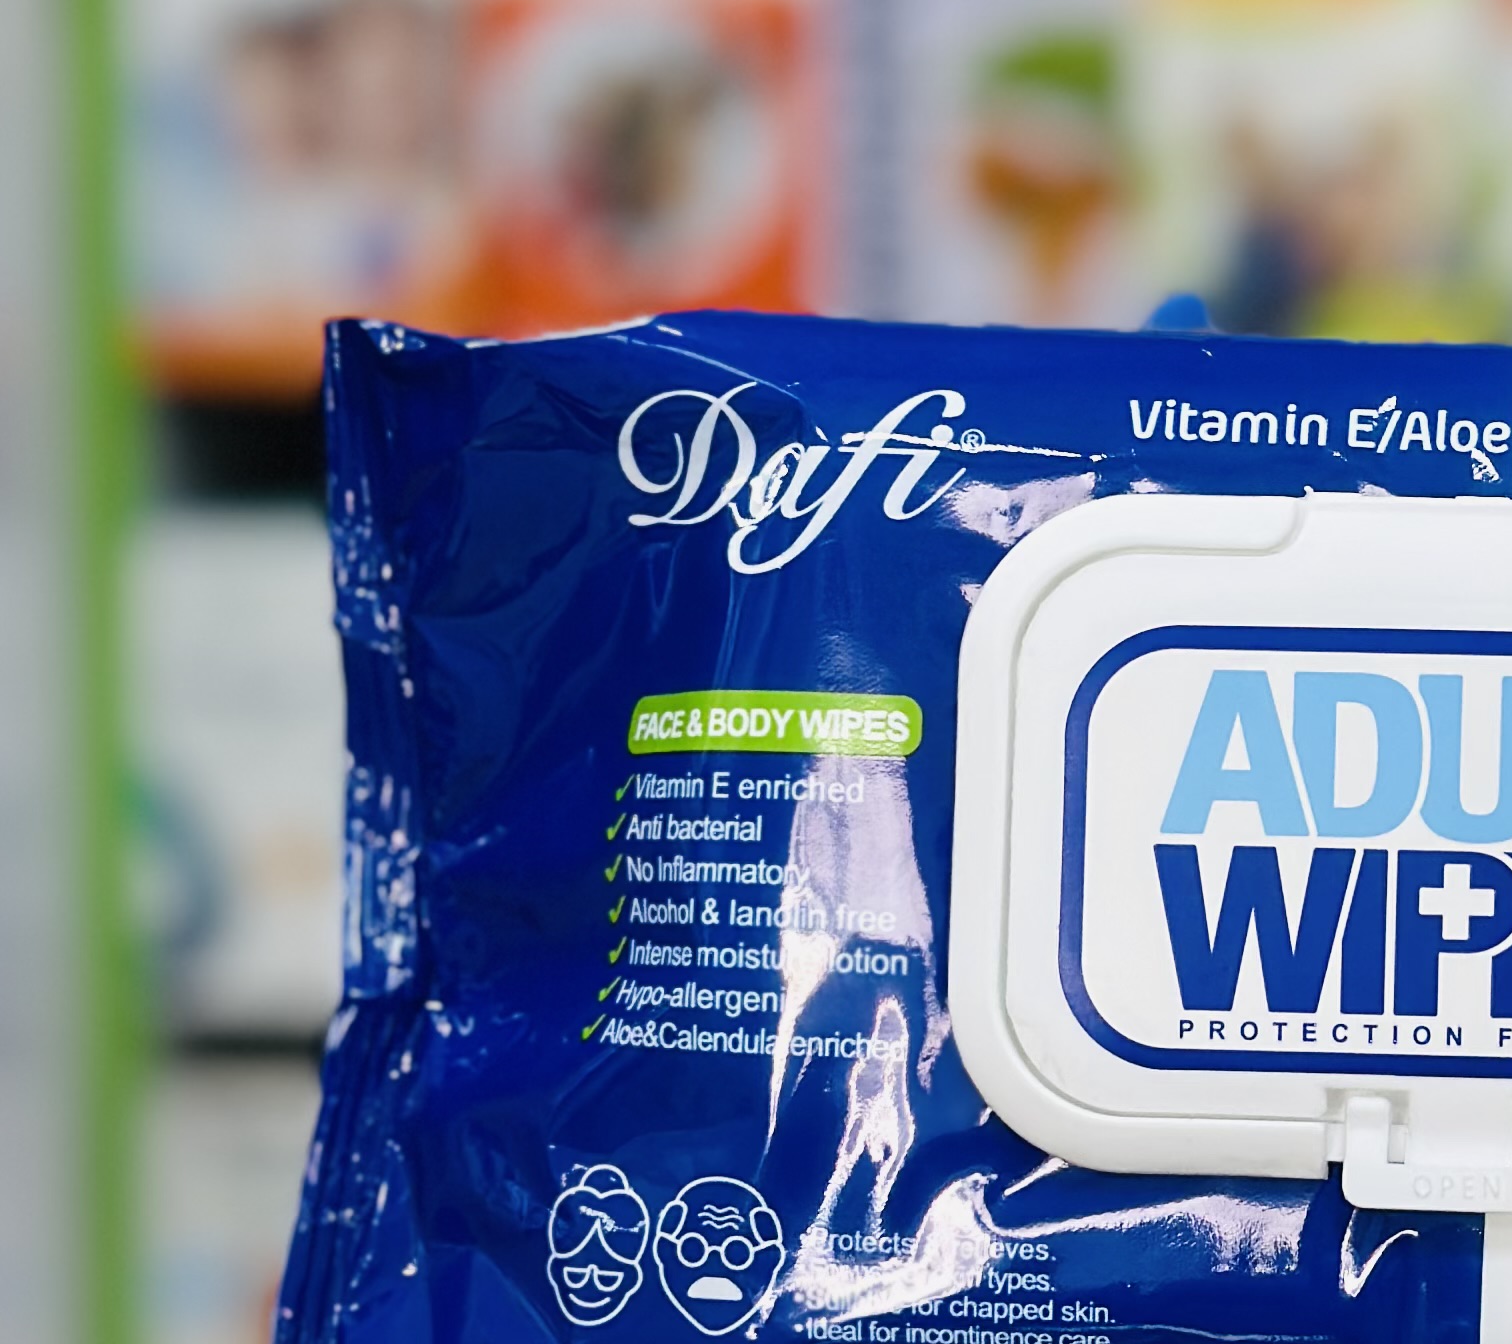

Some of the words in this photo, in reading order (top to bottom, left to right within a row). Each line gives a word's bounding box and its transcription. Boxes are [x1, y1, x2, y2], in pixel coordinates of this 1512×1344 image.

[1130, 400, 1326, 447] Vitamin
[635, 710, 684, 741] FACE
[686, 708, 702, 737] &
[708, 708, 793, 738] BODY
[799, 710, 910, 742] WIPES
[635, 773, 703, 799] Vitamin
[712, 772, 729, 798] E
[739, 777, 864, 803] enriched
[626, 814, 664, 840] Anti
[667, 815, 762, 842] bacterial
[627, 857, 653, 882] No
[658, 856, 810, 892] Inflammatory
[630, 898, 694, 924] Alcohol
[702, 898, 719, 925] &
[730, 900, 826, 929] lanolin
[836, 904, 896, 931] free
[629, 940, 692, 966] Intense
[697, 942, 820, 971] moistu
[616, 979, 795, 1017] Hypo-allergeni
[1179, 1019, 1463, 1047] PROTECTION
[1412, 1174, 1501, 1200] OPEN
[987, 1269, 1056, 1294] types.
[950, 1296, 1053, 1324] chapped
[1061, 1300, 1116, 1324] skin.
[806, 1317, 862, 1342] Ideal
[869, 1320, 900, 1343] for
